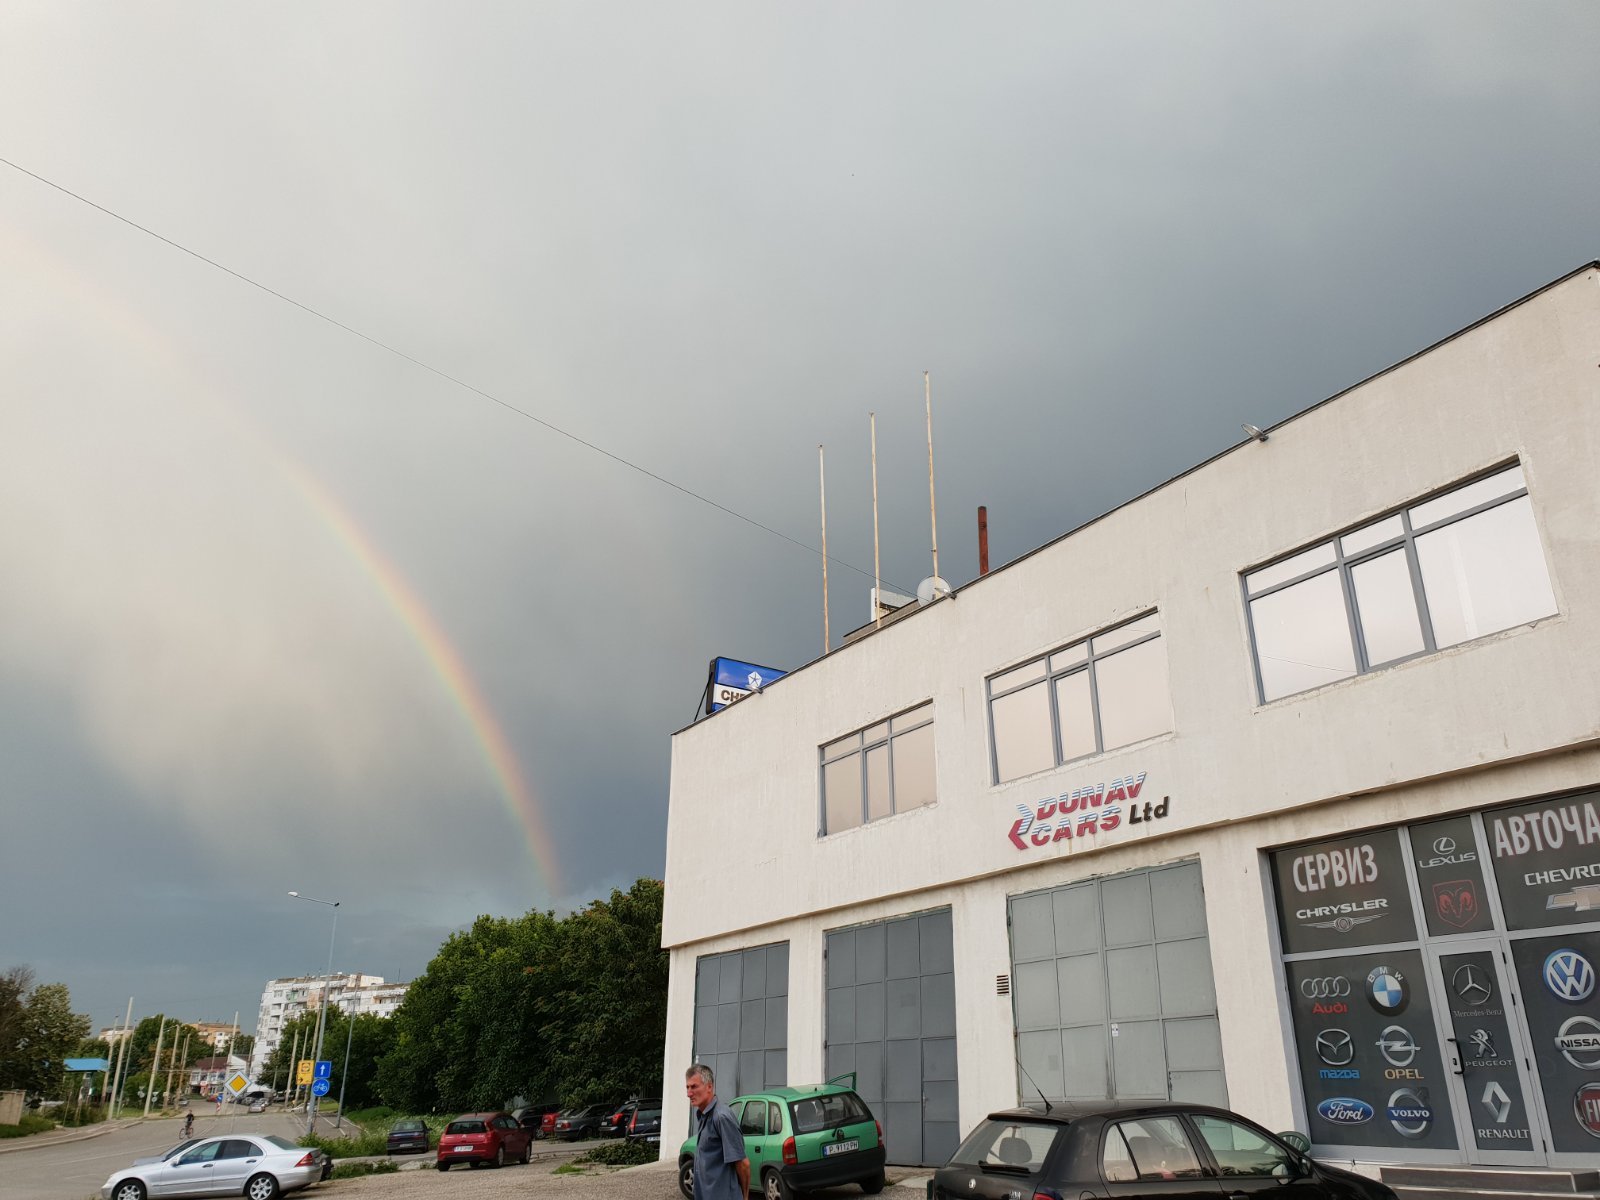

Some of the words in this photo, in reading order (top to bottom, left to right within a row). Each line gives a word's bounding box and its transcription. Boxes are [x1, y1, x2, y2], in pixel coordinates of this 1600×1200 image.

[1037, 771, 1147, 821] DUNAV
[1031, 805, 1121, 847] CARS
[1129, 796, 1169, 825] Ltd
[1494, 803, 1600, 858] АВТОЧА
[1293, 844, 1378, 893] СЕРВИЗ
[1419, 852, 1476, 868] LEXUS
[1296, 898, 1389, 919] CHRYSLER
[1368, 966, 1404, 983] BMW
[1312, 1002, 1348, 1014] Audi
[1453, 1009, 1502, 1018] Mercedes-Benz
[1384, 1069, 1424, 1080] OPEL
[1328, 1103, 1364, 1120] Ford
[1391, 1109, 1430, 1118] VOLVO
[1478, 1128, 1529, 1139] RENAULT
